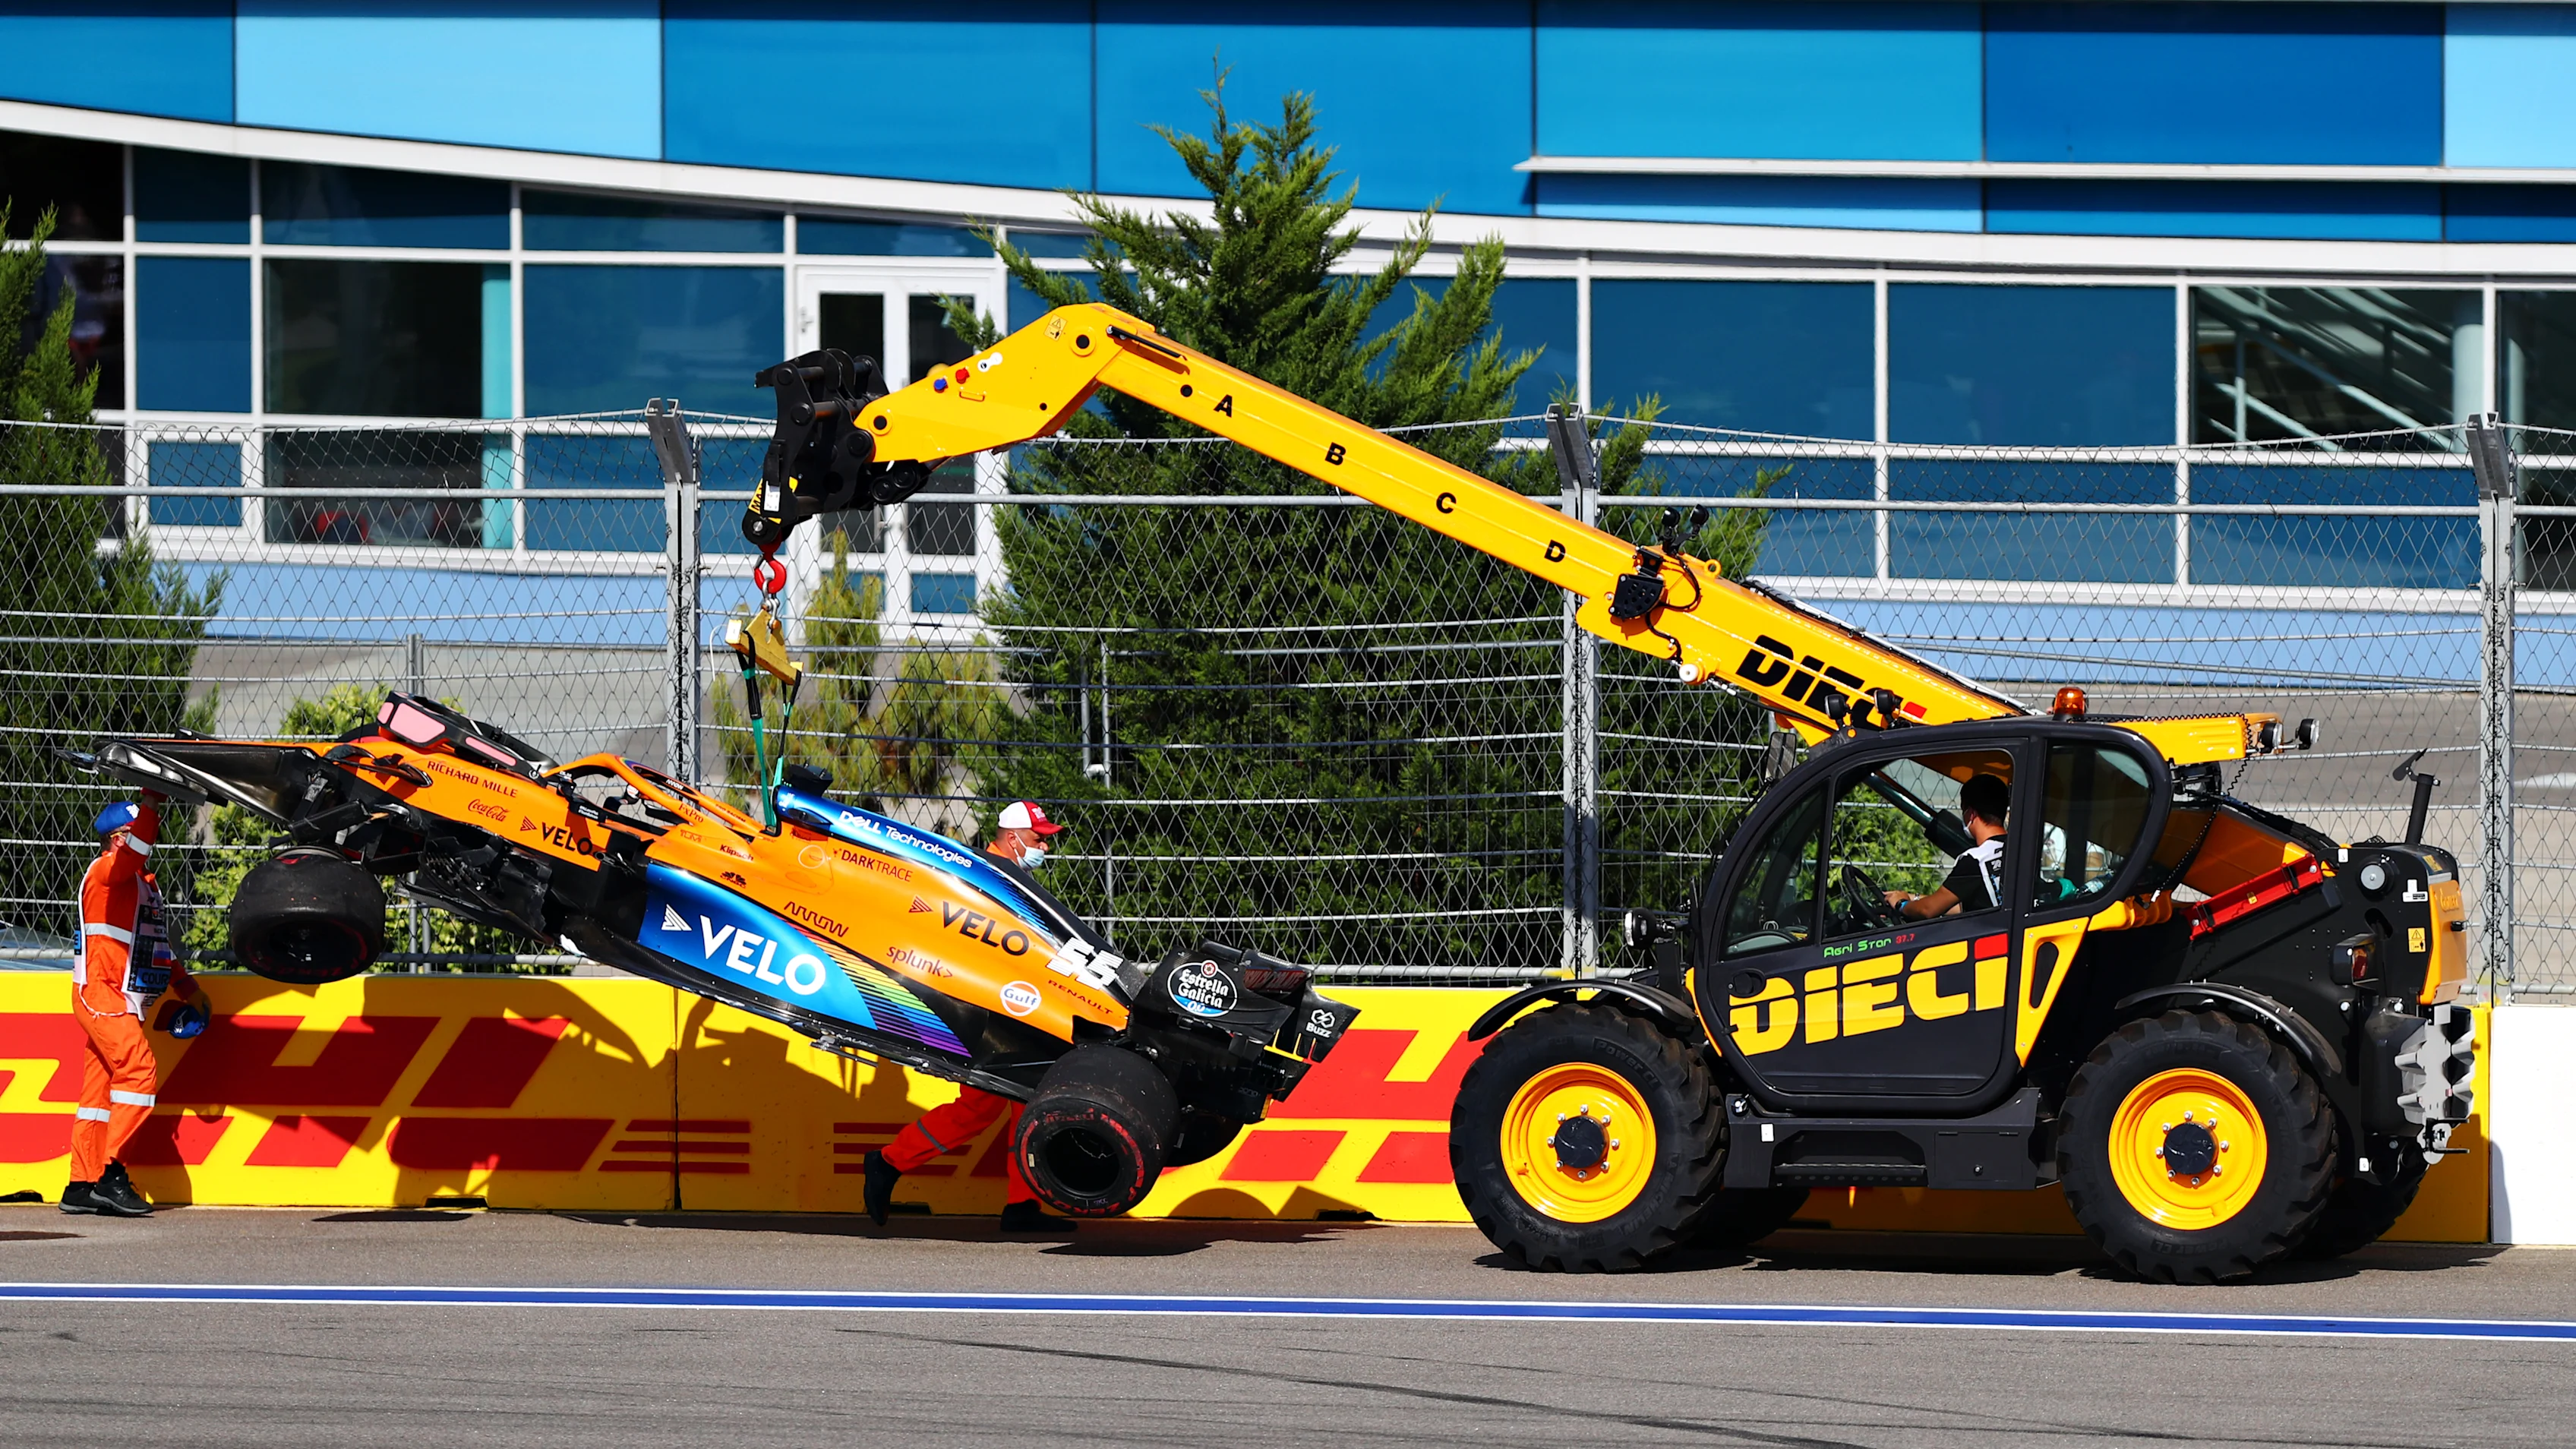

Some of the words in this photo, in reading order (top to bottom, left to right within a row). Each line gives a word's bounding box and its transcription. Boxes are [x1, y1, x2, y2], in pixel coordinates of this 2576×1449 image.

[1214, 394, 1233, 418] A
[1325, 442, 1346, 466] B
[1436, 492, 1457, 514] C
[1545, 539, 1566, 563] D
[427, 761, 478, 784] RICHARD
[481, 779, 518, 797] MILLE
[678, 802, 704, 823] FxPro
[541, 822, 592, 855] VELO
[721, 844, 754, 861] Klipsch
[839, 810, 881, 835] DELL
[886, 825, 973, 868] Technologies
[841, 849, 913, 882] DARKTRACE
[942, 901, 1029, 955] VELO
[699, 914, 826, 995] VELO
[1045, 937, 1124, 990] 55
[1004, 987, 1037, 1006] Gulf
[1048, 979, 1113, 1015] RENAULT
[1178, 983, 1223, 1009] Galicia
[1180, 968, 1230, 996] Estrella
[1729, 933, 2008, 1056] DIECI
